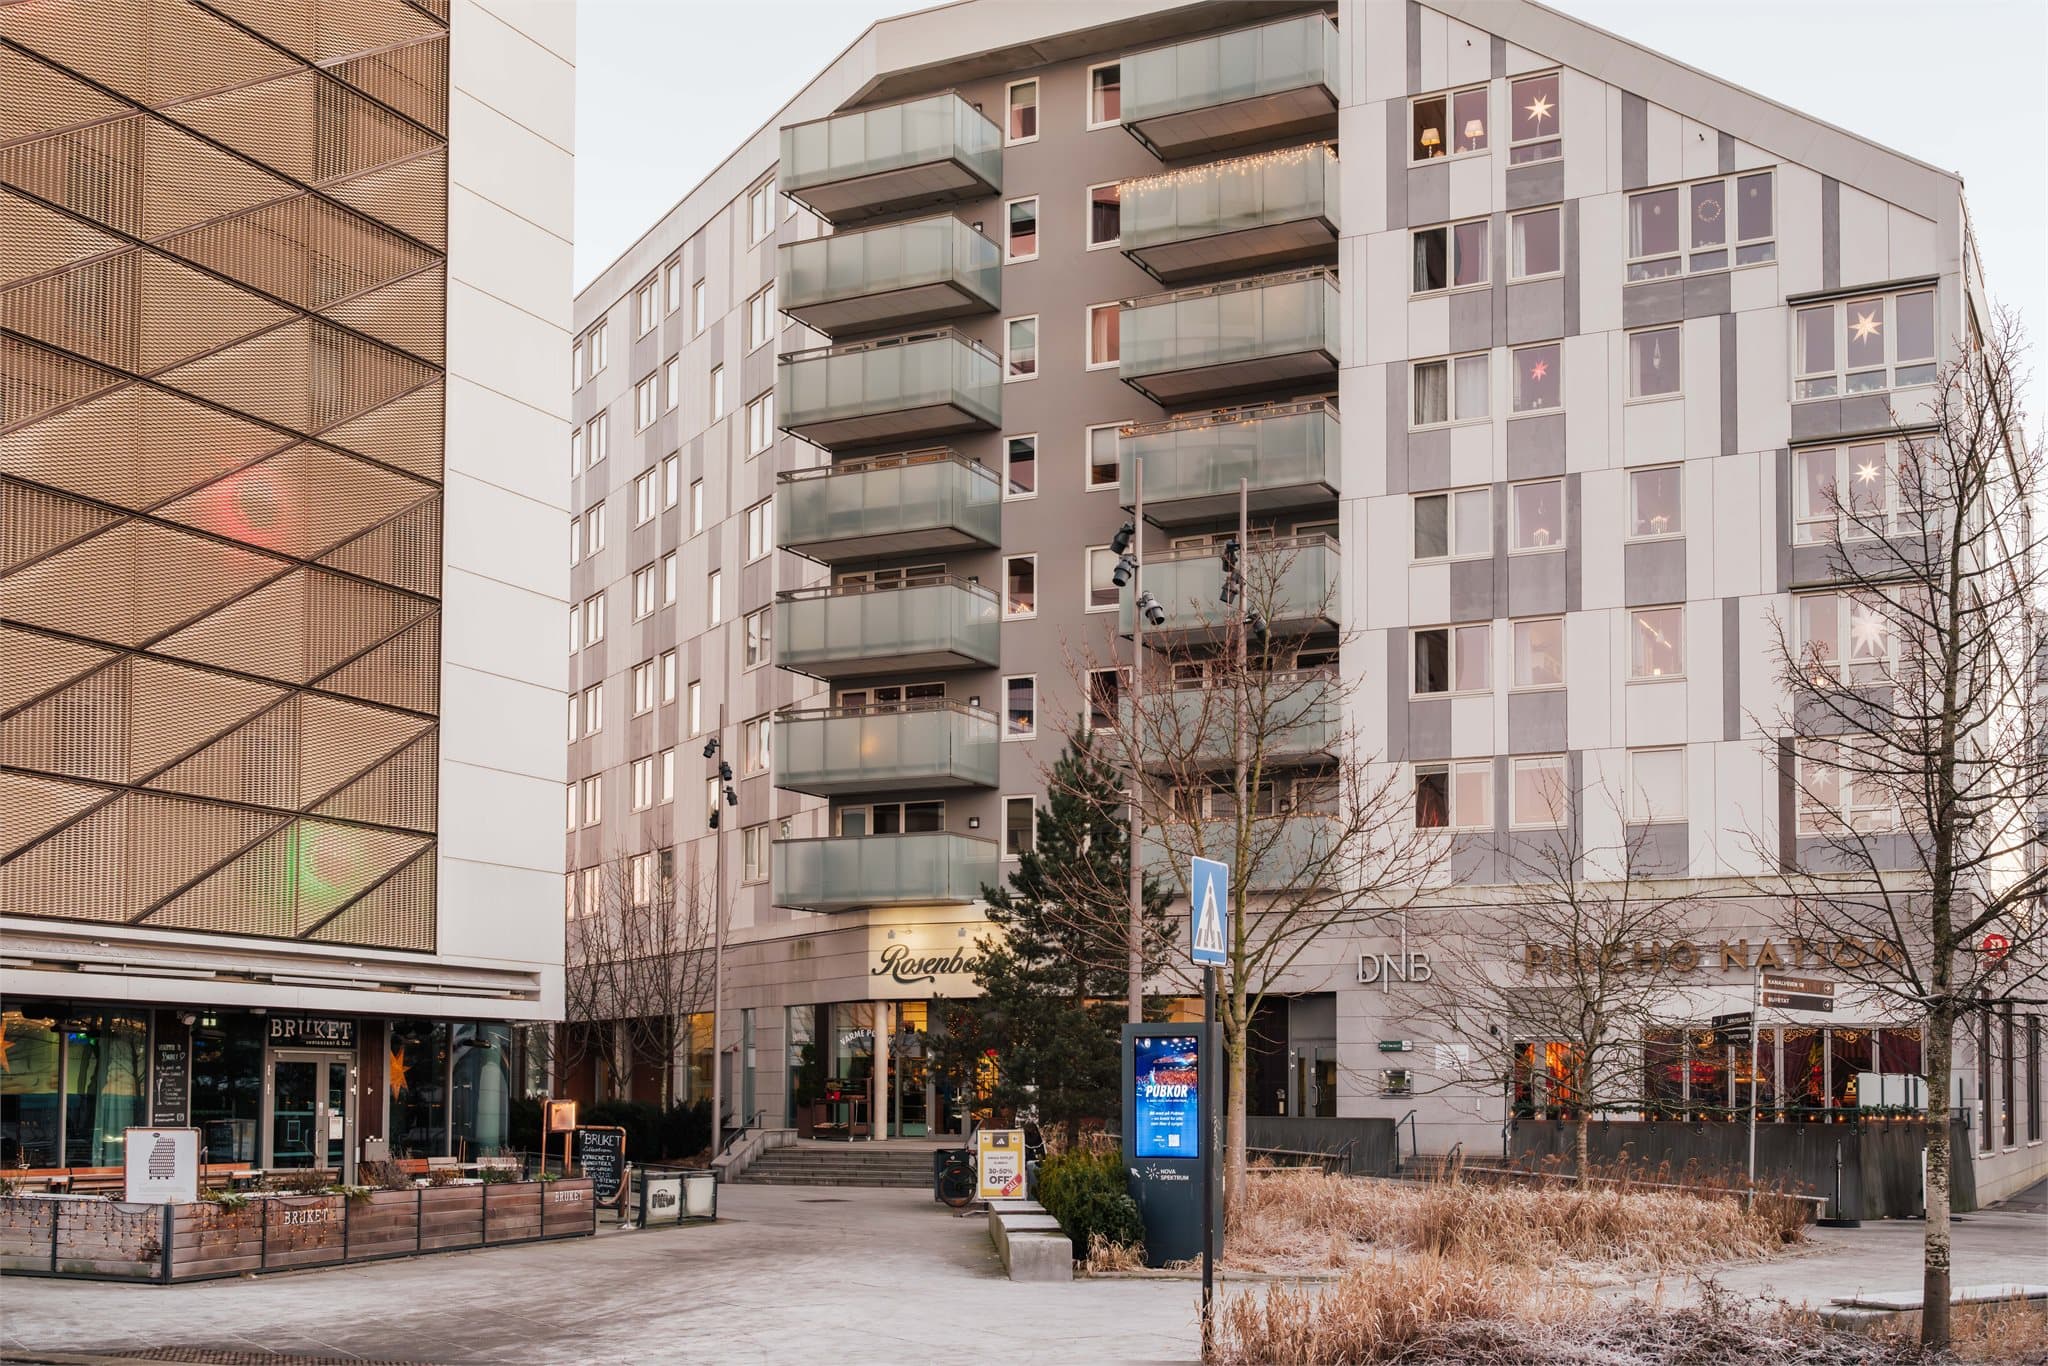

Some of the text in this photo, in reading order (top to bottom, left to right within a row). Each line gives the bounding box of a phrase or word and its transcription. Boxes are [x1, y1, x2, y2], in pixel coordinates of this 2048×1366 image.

[1358, 911, 1432, 994] DNB
[1720, 937, 1905, 972] NATION
[270, 1018, 352, 1040] BRUKET
[1145, 1084, 1188, 1098] PUBKOR
[584, 1133, 622, 1147] BRUKET
[283, 1208, 329, 1225] BRUKET
